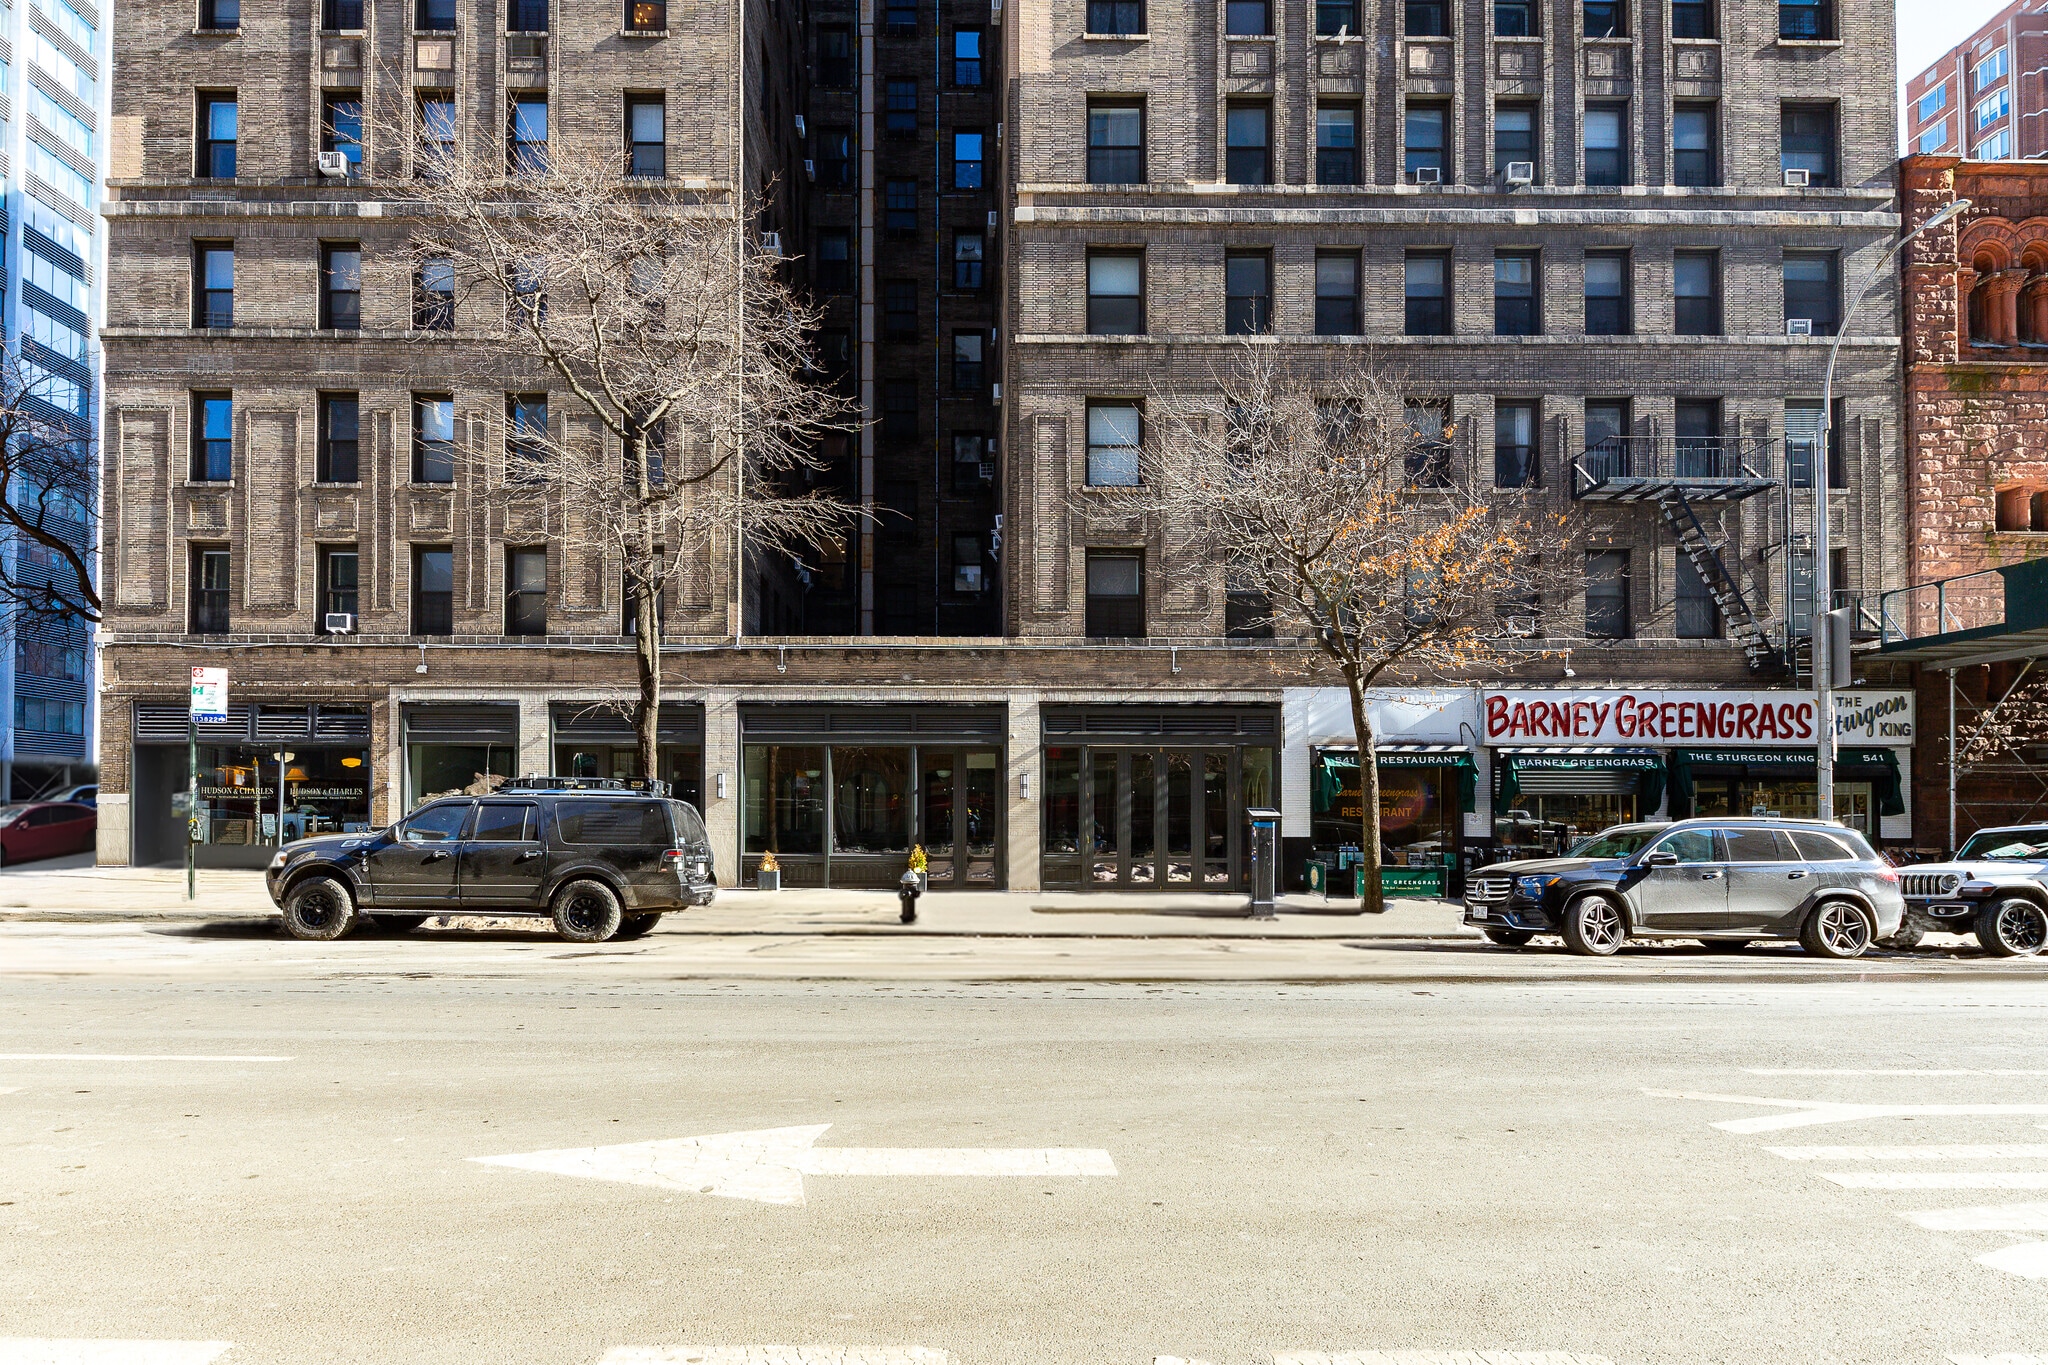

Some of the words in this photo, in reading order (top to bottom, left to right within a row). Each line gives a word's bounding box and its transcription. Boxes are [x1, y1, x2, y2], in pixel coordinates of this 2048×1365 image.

[1835, 697, 1861, 707] THE
[1485, 695, 1611, 739] BARNEY
[1615, 694, 1813, 740] GREENGRASS
[1829, 695, 1907, 738] turgeon
[1879, 722, 1911, 737] KING
[1380, 756, 1460, 764] RESTAURANT
[1688, 753, 1713, 761] THE
[1716, 753, 1782, 762] STURGEON
[1862, 754, 1884, 762] 541
[1518, 759, 1566, 767] BARNEY
[1570, 758, 1653, 767] GREENGRASS
[201, 787, 232, 795] HUDSON
[239, 787, 274, 795] CHARLES
[290, 788, 321, 796] HUDSON
[328, 788, 363, 796] CHARLES
